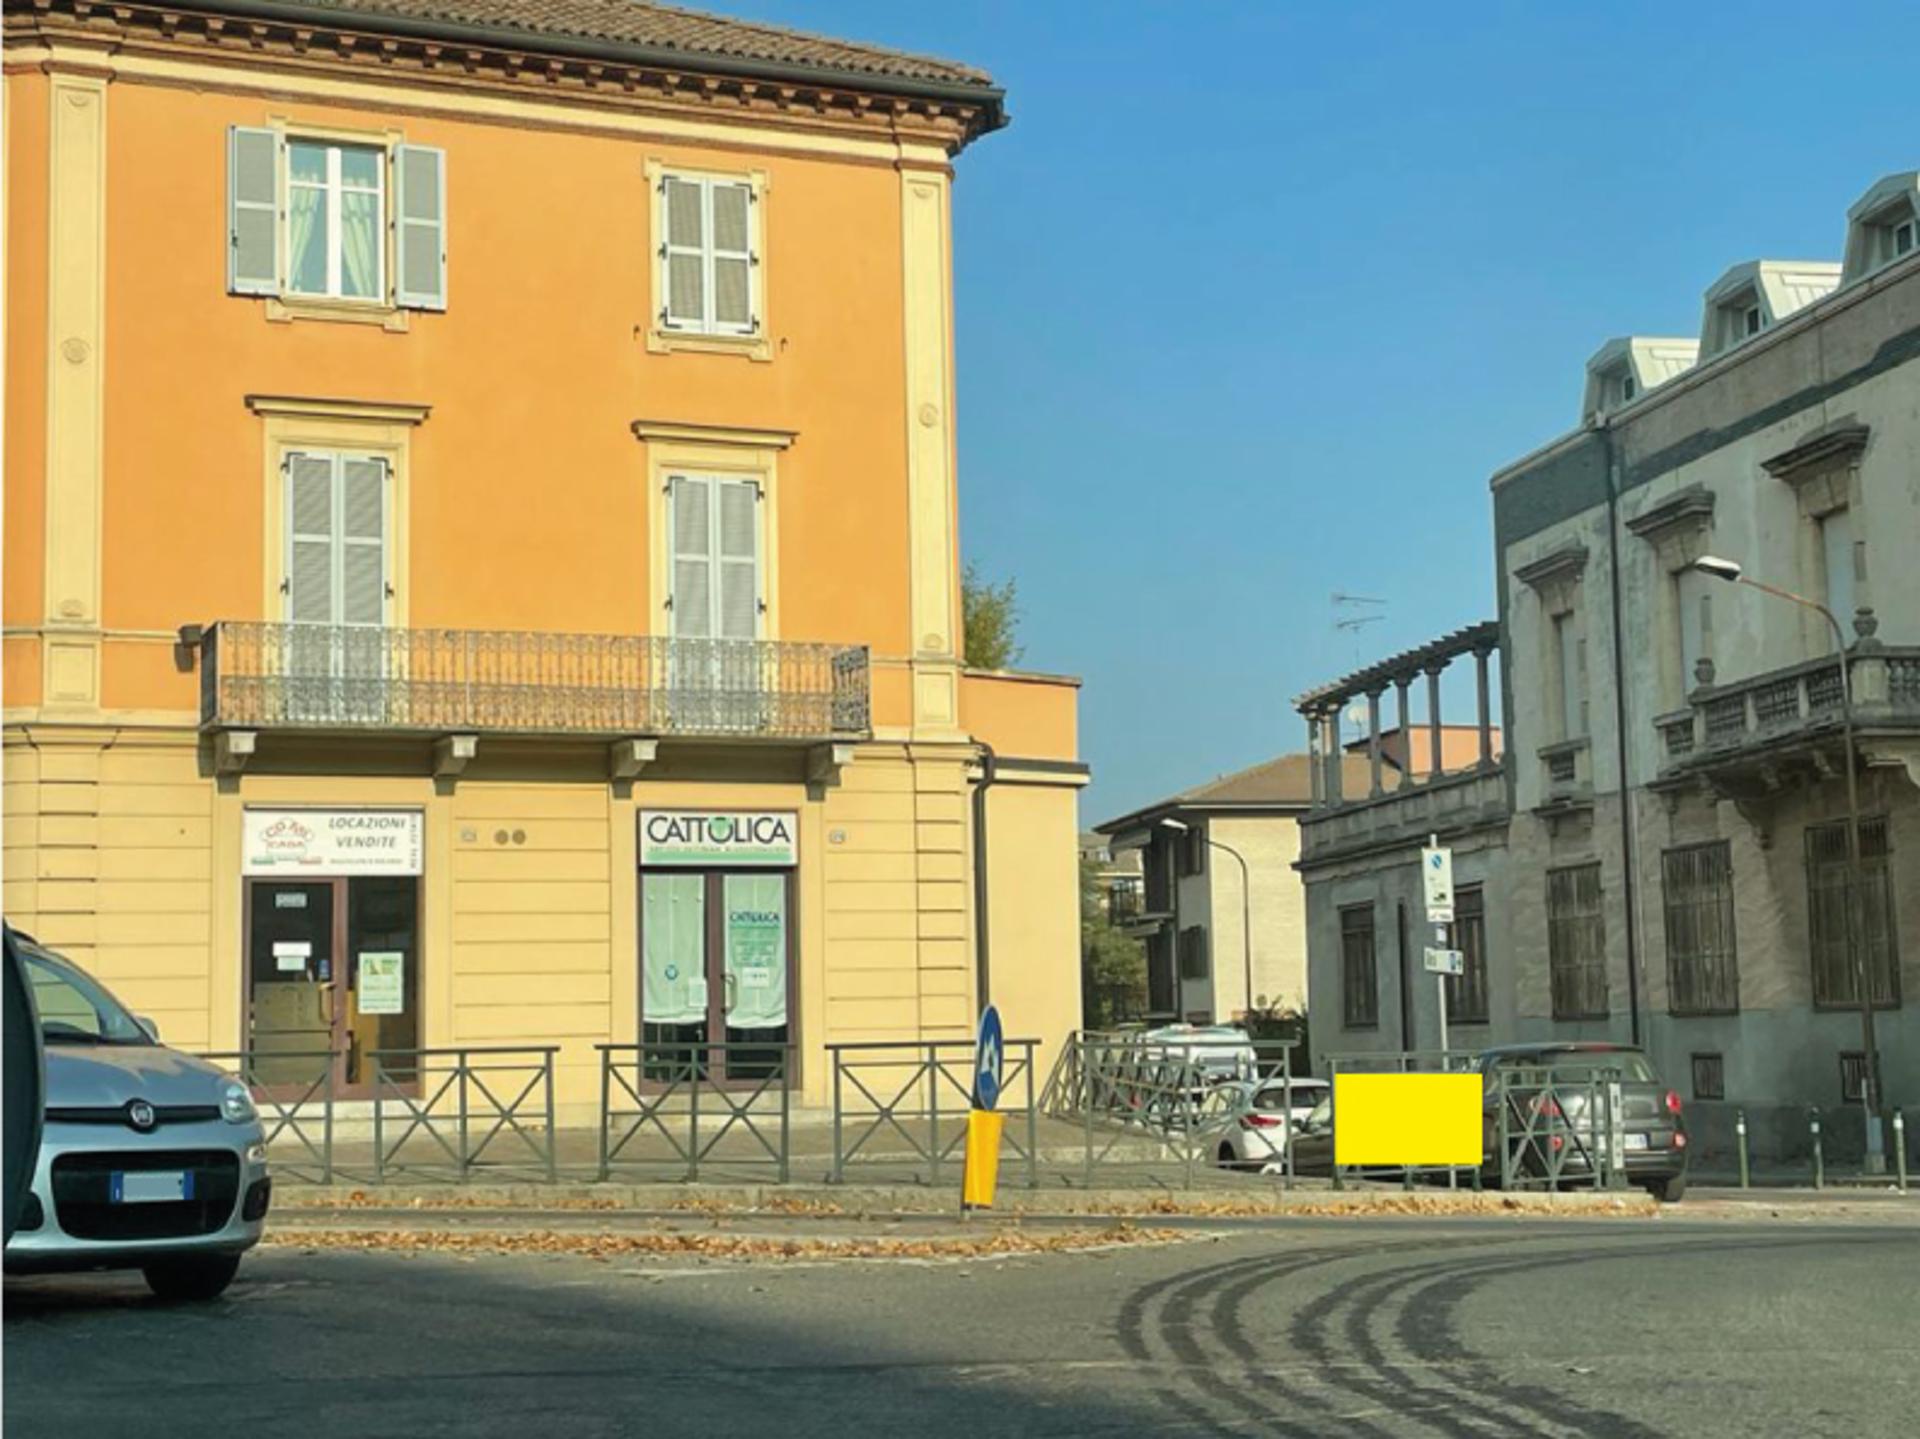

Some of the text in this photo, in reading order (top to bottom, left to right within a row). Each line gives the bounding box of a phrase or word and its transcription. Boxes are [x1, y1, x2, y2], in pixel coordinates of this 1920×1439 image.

[329, 817, 406, 830] LOCAZIONI
[647, 815, 791, 844] CATTOLICA
[336, 836, 397, 848] VENDITE
